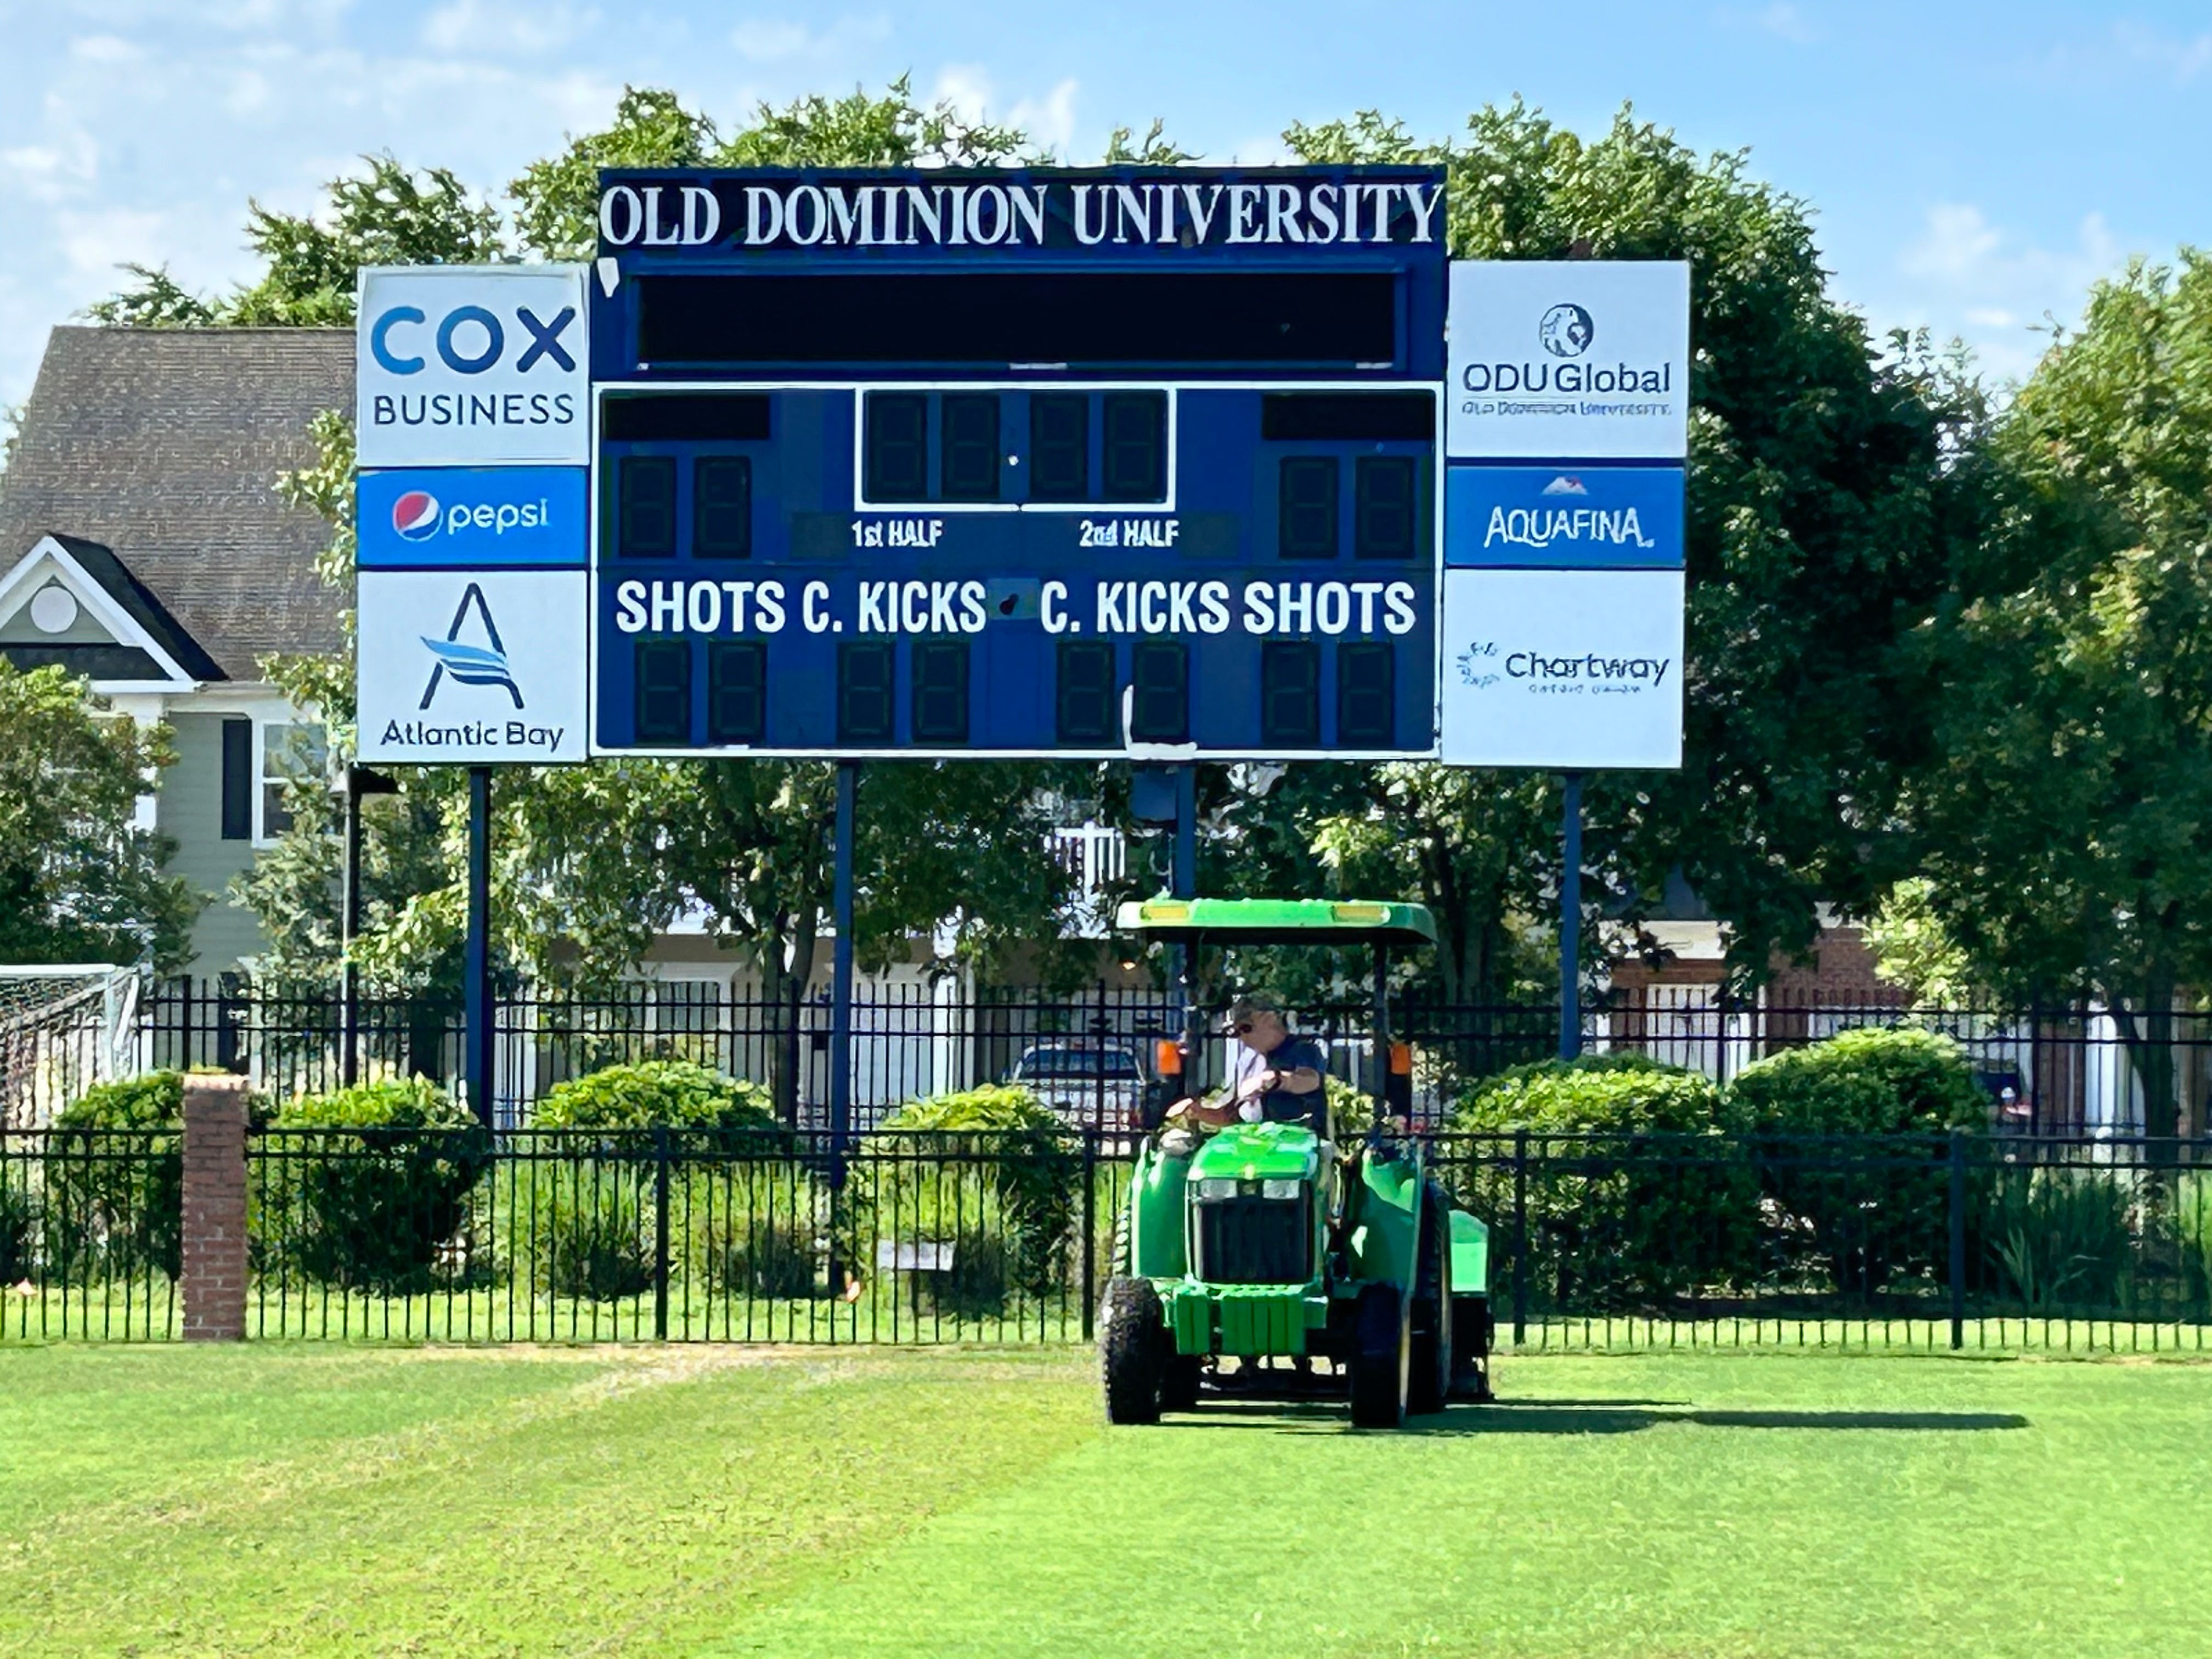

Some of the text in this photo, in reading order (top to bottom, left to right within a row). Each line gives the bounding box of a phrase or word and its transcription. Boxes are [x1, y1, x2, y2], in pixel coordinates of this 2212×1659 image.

[599, 184, 1445, 245] OLD DOMINION UNIVERSITY
[370, 305, 577, 376] COX
[374, 393, 574, 426] BUSINESS
[448, 498, 550, 535] pepsi
[888, 519, 943, 548] HALF
[1122, 519, 1180, 548] HALF
[1483, 505, 1655, 549] AQUAFINA
[616, 580, 786, 633] SHOTS
[802, 580, 987, 634] C. KICKS
[1040, 580, 1231, 634] C. KICKS
[1243, 580, 1417, 635] SHOTS
[1505, 651, 1671, 687] Chartway
[380, 719, 565, 753] Atlantic Bay
